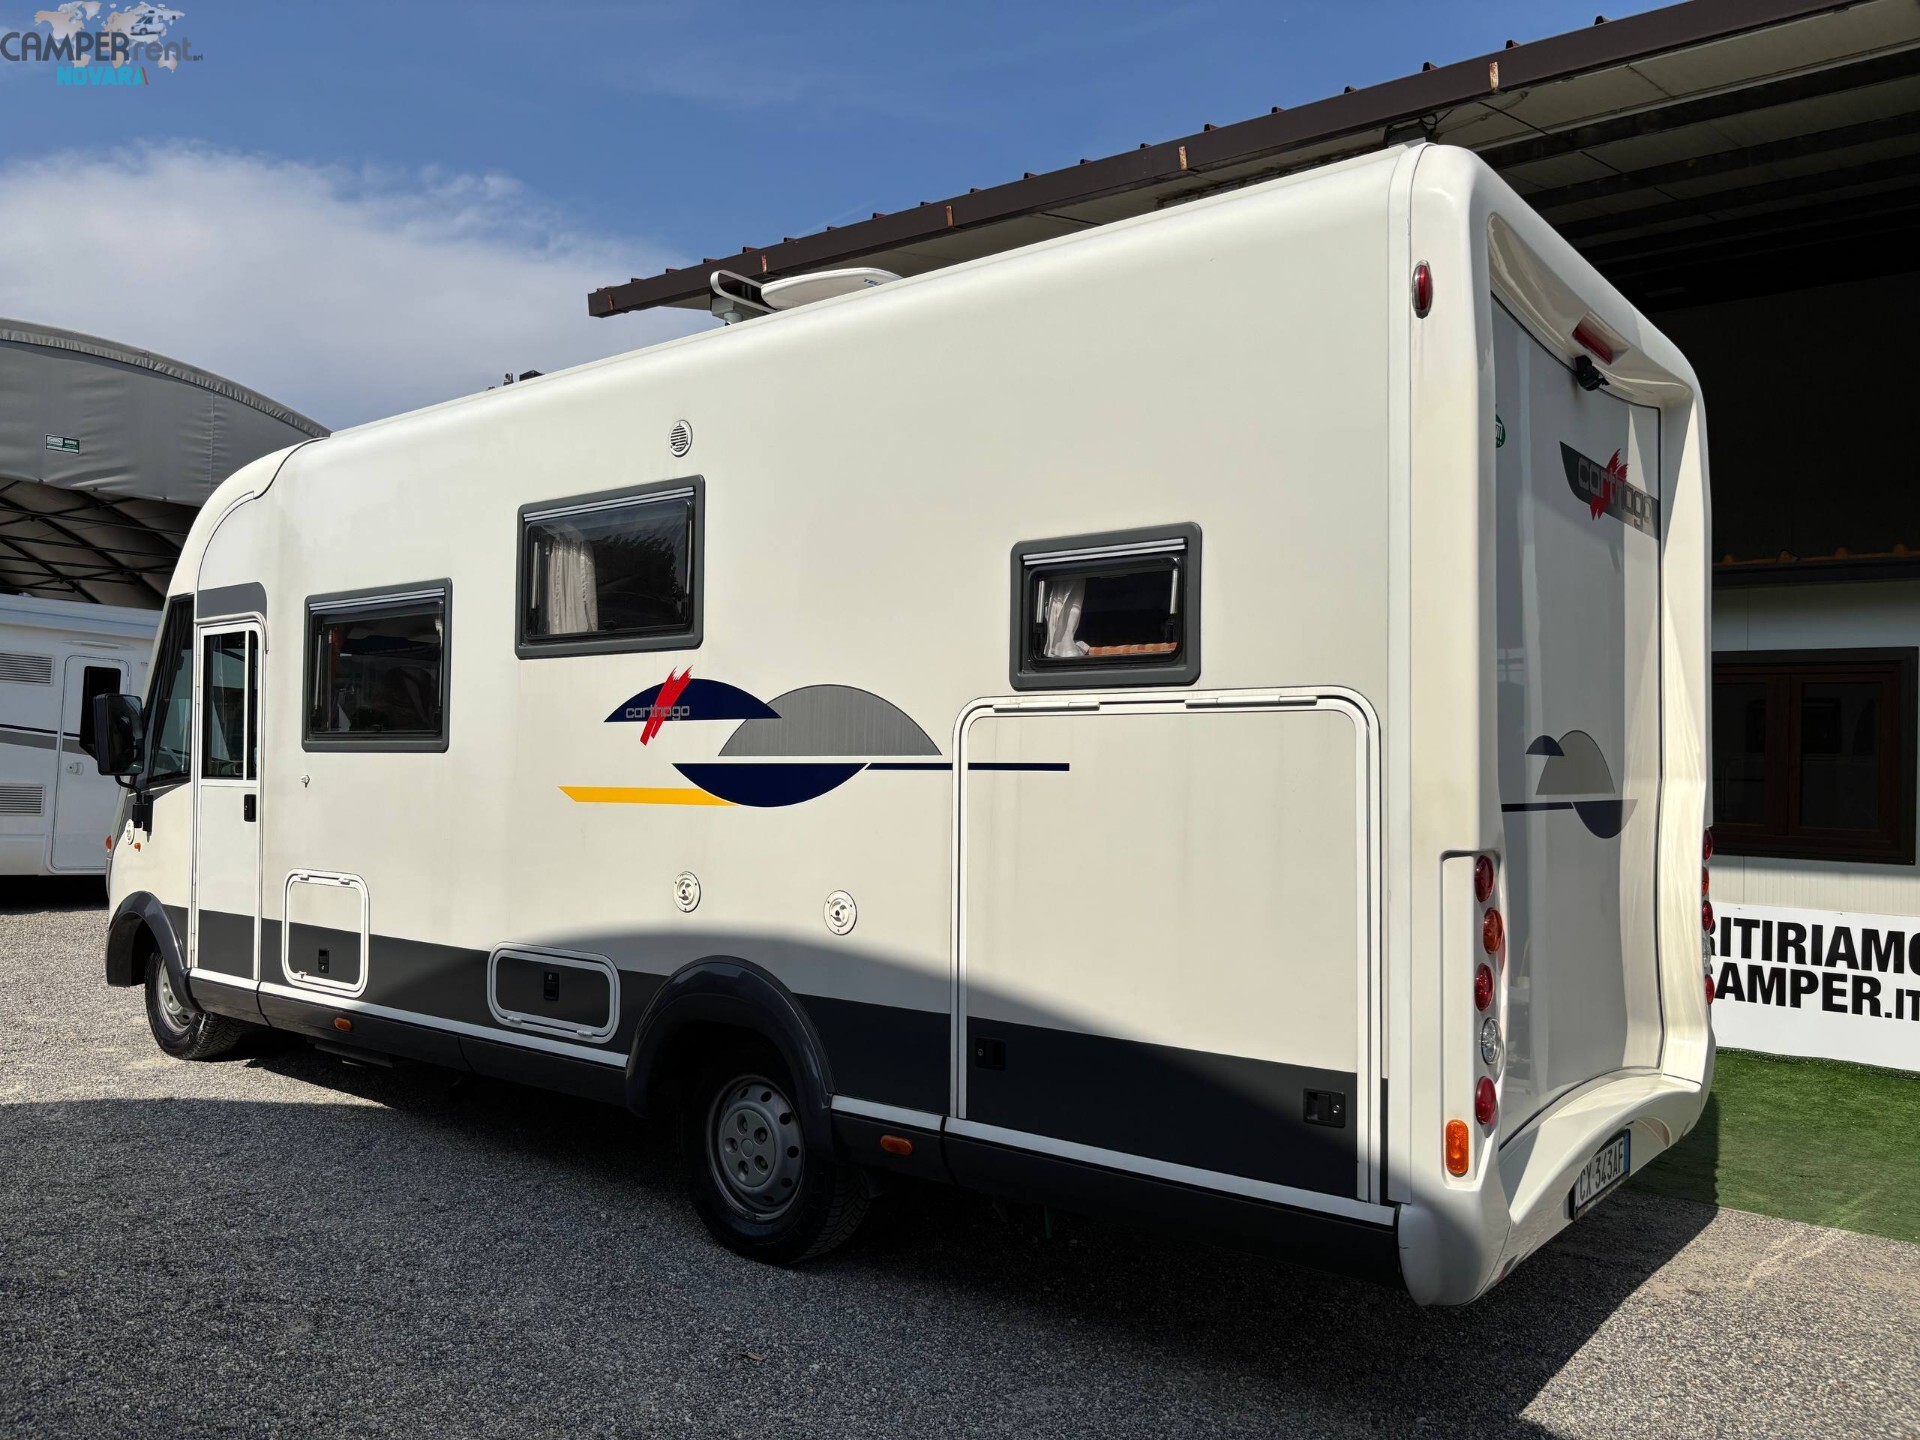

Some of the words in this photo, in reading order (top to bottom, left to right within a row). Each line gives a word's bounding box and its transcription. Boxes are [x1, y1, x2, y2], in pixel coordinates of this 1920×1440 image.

[1578, 456, 1653, 531] carthago
[625, 704, 690, 721] carthago
[1709, 916, 1920, 978] ITIRIAM
[1711, 961, 1920, 1022] AMPER.IT
